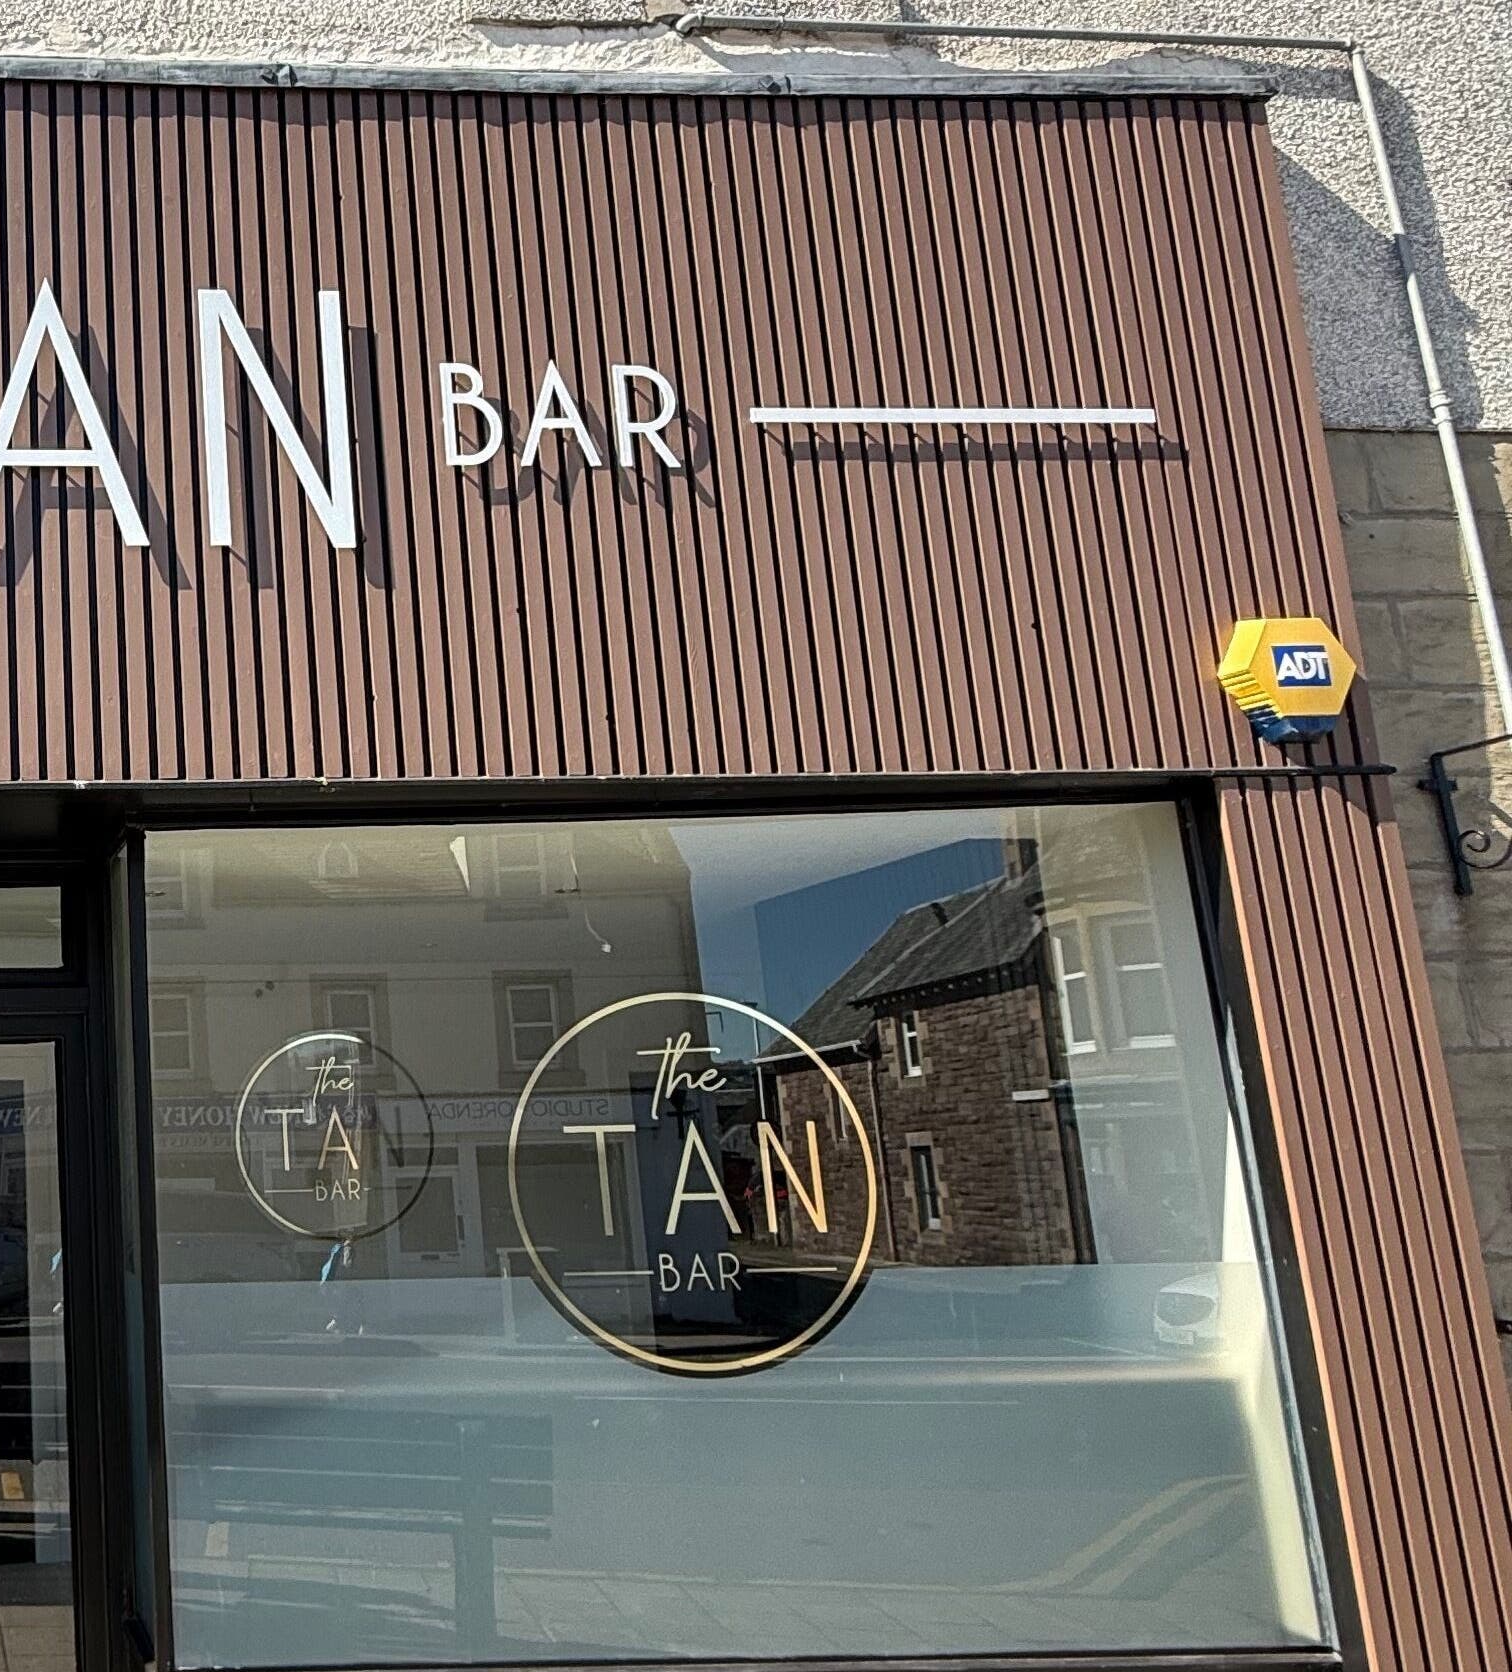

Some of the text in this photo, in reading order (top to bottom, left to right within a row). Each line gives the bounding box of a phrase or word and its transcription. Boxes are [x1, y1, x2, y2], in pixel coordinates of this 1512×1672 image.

[439, 359, 683, 468] BAR
[1277, 651, 1329, 681] ADT
[305, 1056, 355, 1106] the
[636, 1031, 728, 1120] the
[315, 1179, 361, 1201] BAR
[563, 1119, 828, 1238] TAN
[658, 1252, 743, 1292] BAR
